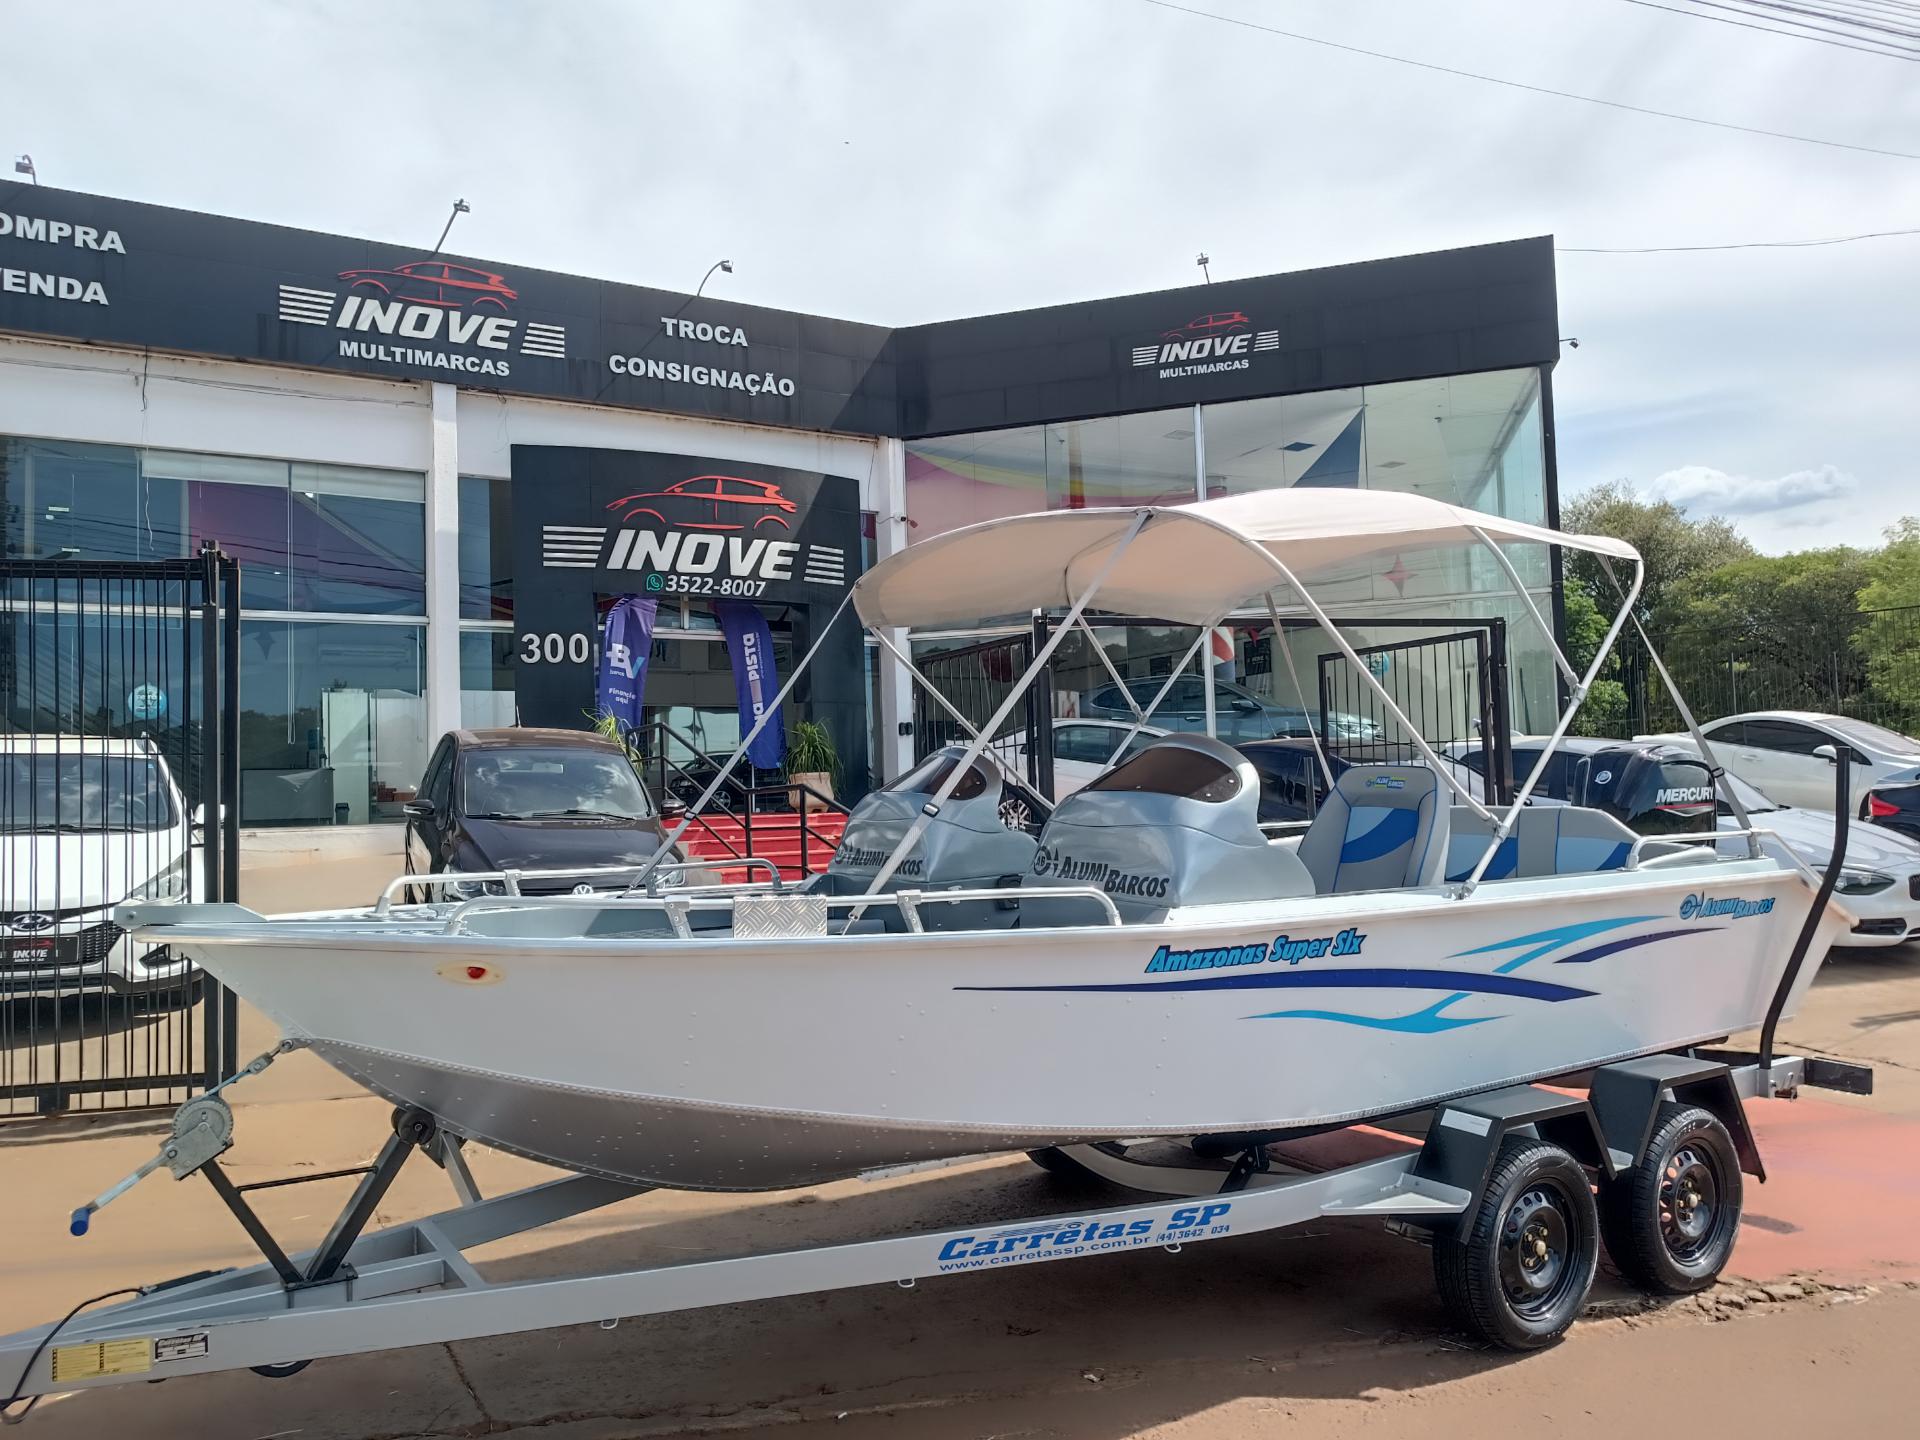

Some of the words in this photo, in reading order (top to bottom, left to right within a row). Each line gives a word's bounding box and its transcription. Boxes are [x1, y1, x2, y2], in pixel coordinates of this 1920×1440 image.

[0, 267, 109, 306] ENDA
[336, 296, 517, 350] INOVE
[661, 317, 748, 347] TROCA
[339, 340, 510, 377] MULTIMARCAS
[1158, 333, 1252, 364] INOVE
[609, 354, 795, 397] CONSIGNAÇÃO
[1159, 358, 1249, 379] MULTIMARCAS
[607, 528, 800, 580] INOVE
[665, 575, 767, 598] 3522-8007
[520, 633, 589, 664] 300
[1656, 786, 1714, 803] MERCURY
[850, 848, 924, 876] ALUMICOS
[1145, 943, 1269, 974] Amazonas
[1269, 935, 1332, 965] Super
[938, 1220, 1154, 1261] Carretas
[1167, 1203, 1232, 1231] SP
[939, 1235, 1151, 1272] www.carretassp.com.br
